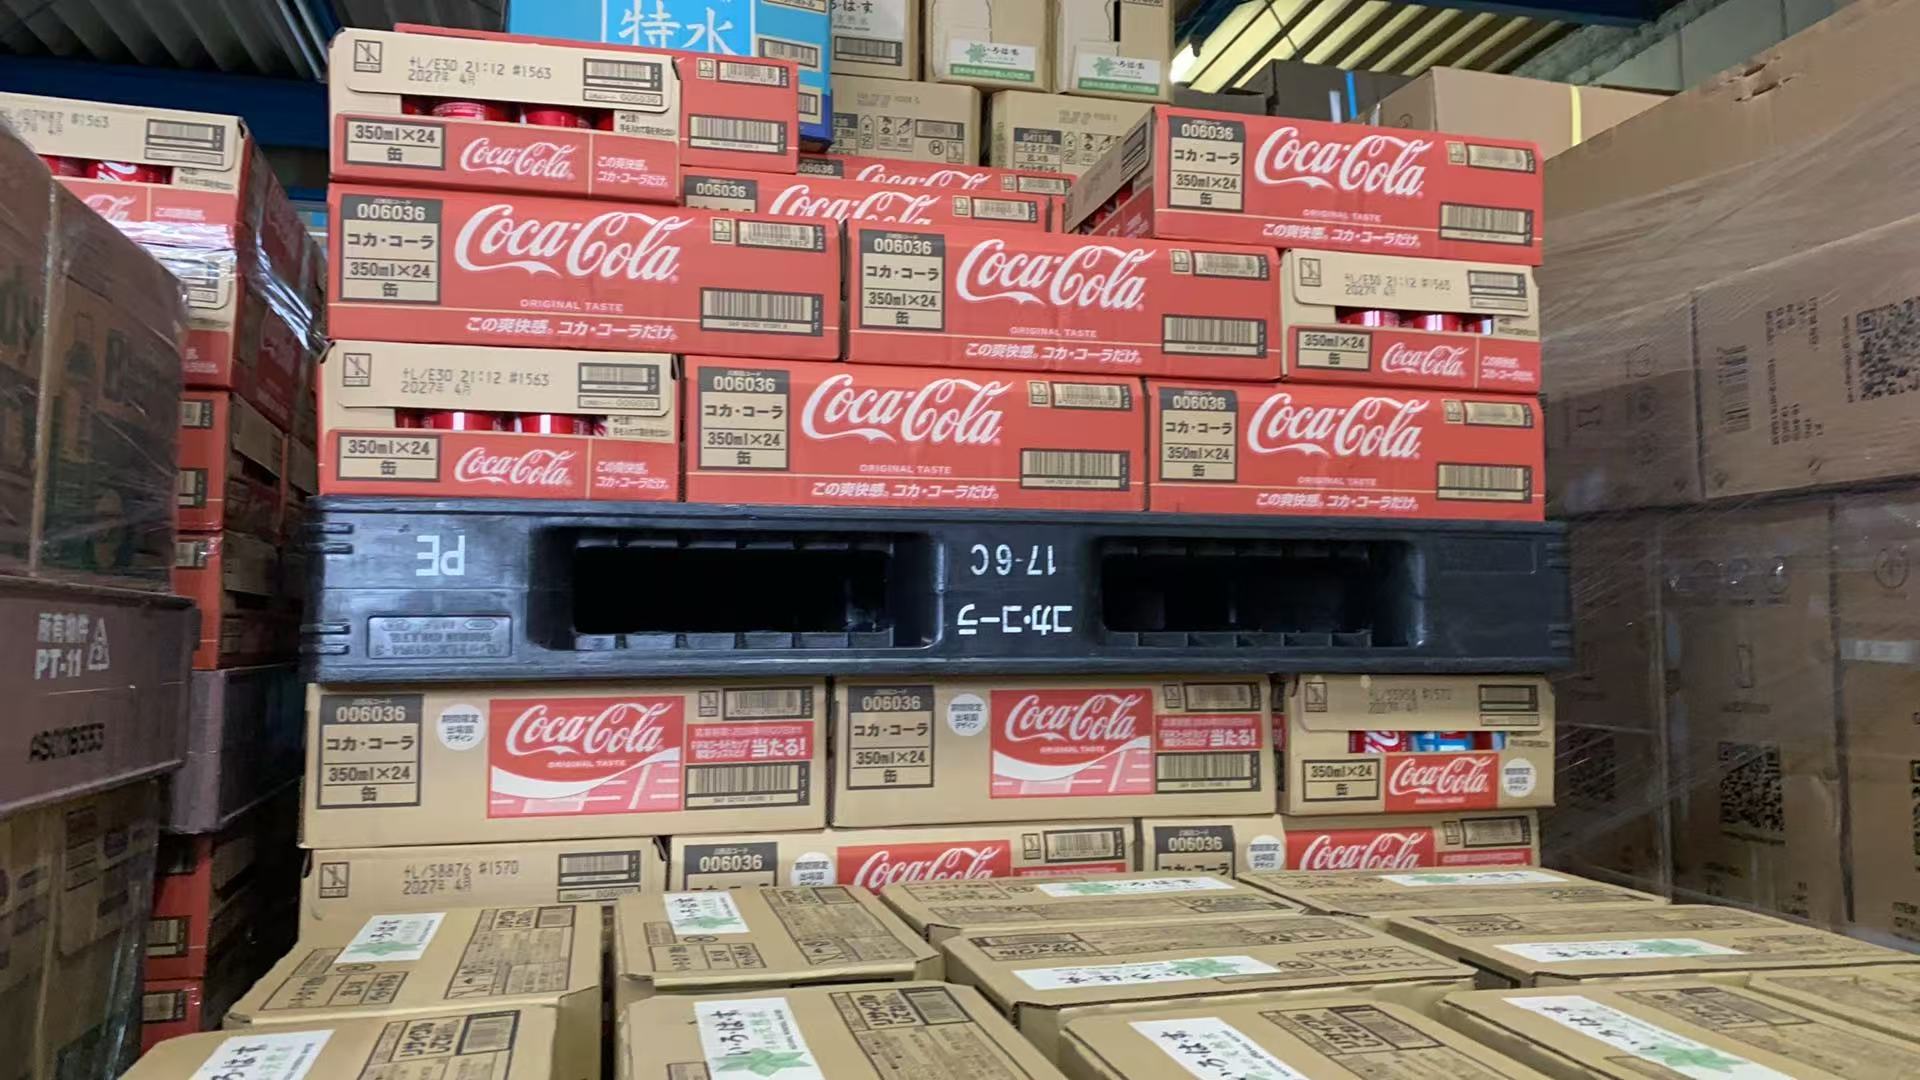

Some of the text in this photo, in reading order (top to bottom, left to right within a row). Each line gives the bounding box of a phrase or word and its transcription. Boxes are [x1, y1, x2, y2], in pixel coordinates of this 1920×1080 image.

[465, 60, 505, 76] 21:12
[512, 65, 552, 80] #1563
[355, 124, 435, 144] 350ml×24
[1180, 122, 1234, 140] 006036
[386, 147, 403, 163] 缶
[460, 136, 578, 181] Coca-Cola
[1173, 148, 1240, 166] コカ・コーラ
[1254, 126, 1435, 198] Coca-Cola
[696, 182, 746, 198] 006036
[1176, 173, 1238, 191] 350ml×24
[1200, 191, 1213, 205] 缶
[357, 203, 426, 221] 006036
[347, 230, 435, 251] コカ・コーラ
[454, 203, 695, 282] Coca-Cola
[873, 237, 932, 255] 006036
[350, 260, 431, 279] 350ml×24
[866, 263, 940, 282] コカ・コーラ
[956, 238, 1157, 310] Coca-Cola
[381, 281, 399, 298] 缶
[519, 298, 624, 313] ORIGINAL TASTE
[868, 291, 937, 308] 350ml×24
[896, 311, 909, 325] 缶
[1063, 328, 1097, 339] TASTE
[1304, 333, 1366, 348] 350ml×24
[1381, 342, 1468, 376] Coca-Cola
[461, 370, 501, 384] 21:12
[509, 371, 549, 387] #1563
[714, 375, 776, 393] 006036
[704, 403, 784, 419] コカ・コーラ
[801, 374, 1014, 445] Coca-Cola
[1172, 395, 1227, 411] 006036
[1165, 420, 1233, 436] コカ・コーラ
[1247, 392, 1430, 459] Coca-Cola
[348, 439, 430, 456] 350ml×24
[708, 431, 781, 448] 350ml×24
[736, 451, 752, 466] 缶
[1167, 446, 1230, 461] 350ml×24
[380, 461, 397, 475] 缶
[454, 447, 576, 487] Coca-Cola
[860, 463, 952, 475] ORIGINAL TASTE
[1192, 463, 1206, 478] 缶
[416, 534, 465, 576] PE
[957, 603, 1073, 636] コカ・コーラ
[34, 648, 82, 680] PT-11
[862, 695, 921, 711] 006036
[336, 705, 406, 722] 006036
[1004, 693, 1144, 743] Coca-Cola
[506, 702, 673, 757] Coca-Cola
[853, 722, 929, 738] コカ・コーラ
[326, 735, 415, 752] コカ・コーラ
[855, 750, 926, 766] 350ml×24
[329, 766, 411, 783] 350ml×24
[883, 768, 898, 784] 缶
[1310, 764, 1373, 778] 350ml×24
[1389, 756, 1495, 796] Coca-Cola
[361, 786, 377, 802] 缶
[1168, 836, 1223, 852] 006036
[479, 860, 520, 876] #1570
[699, 853, 763, 872] 006036
